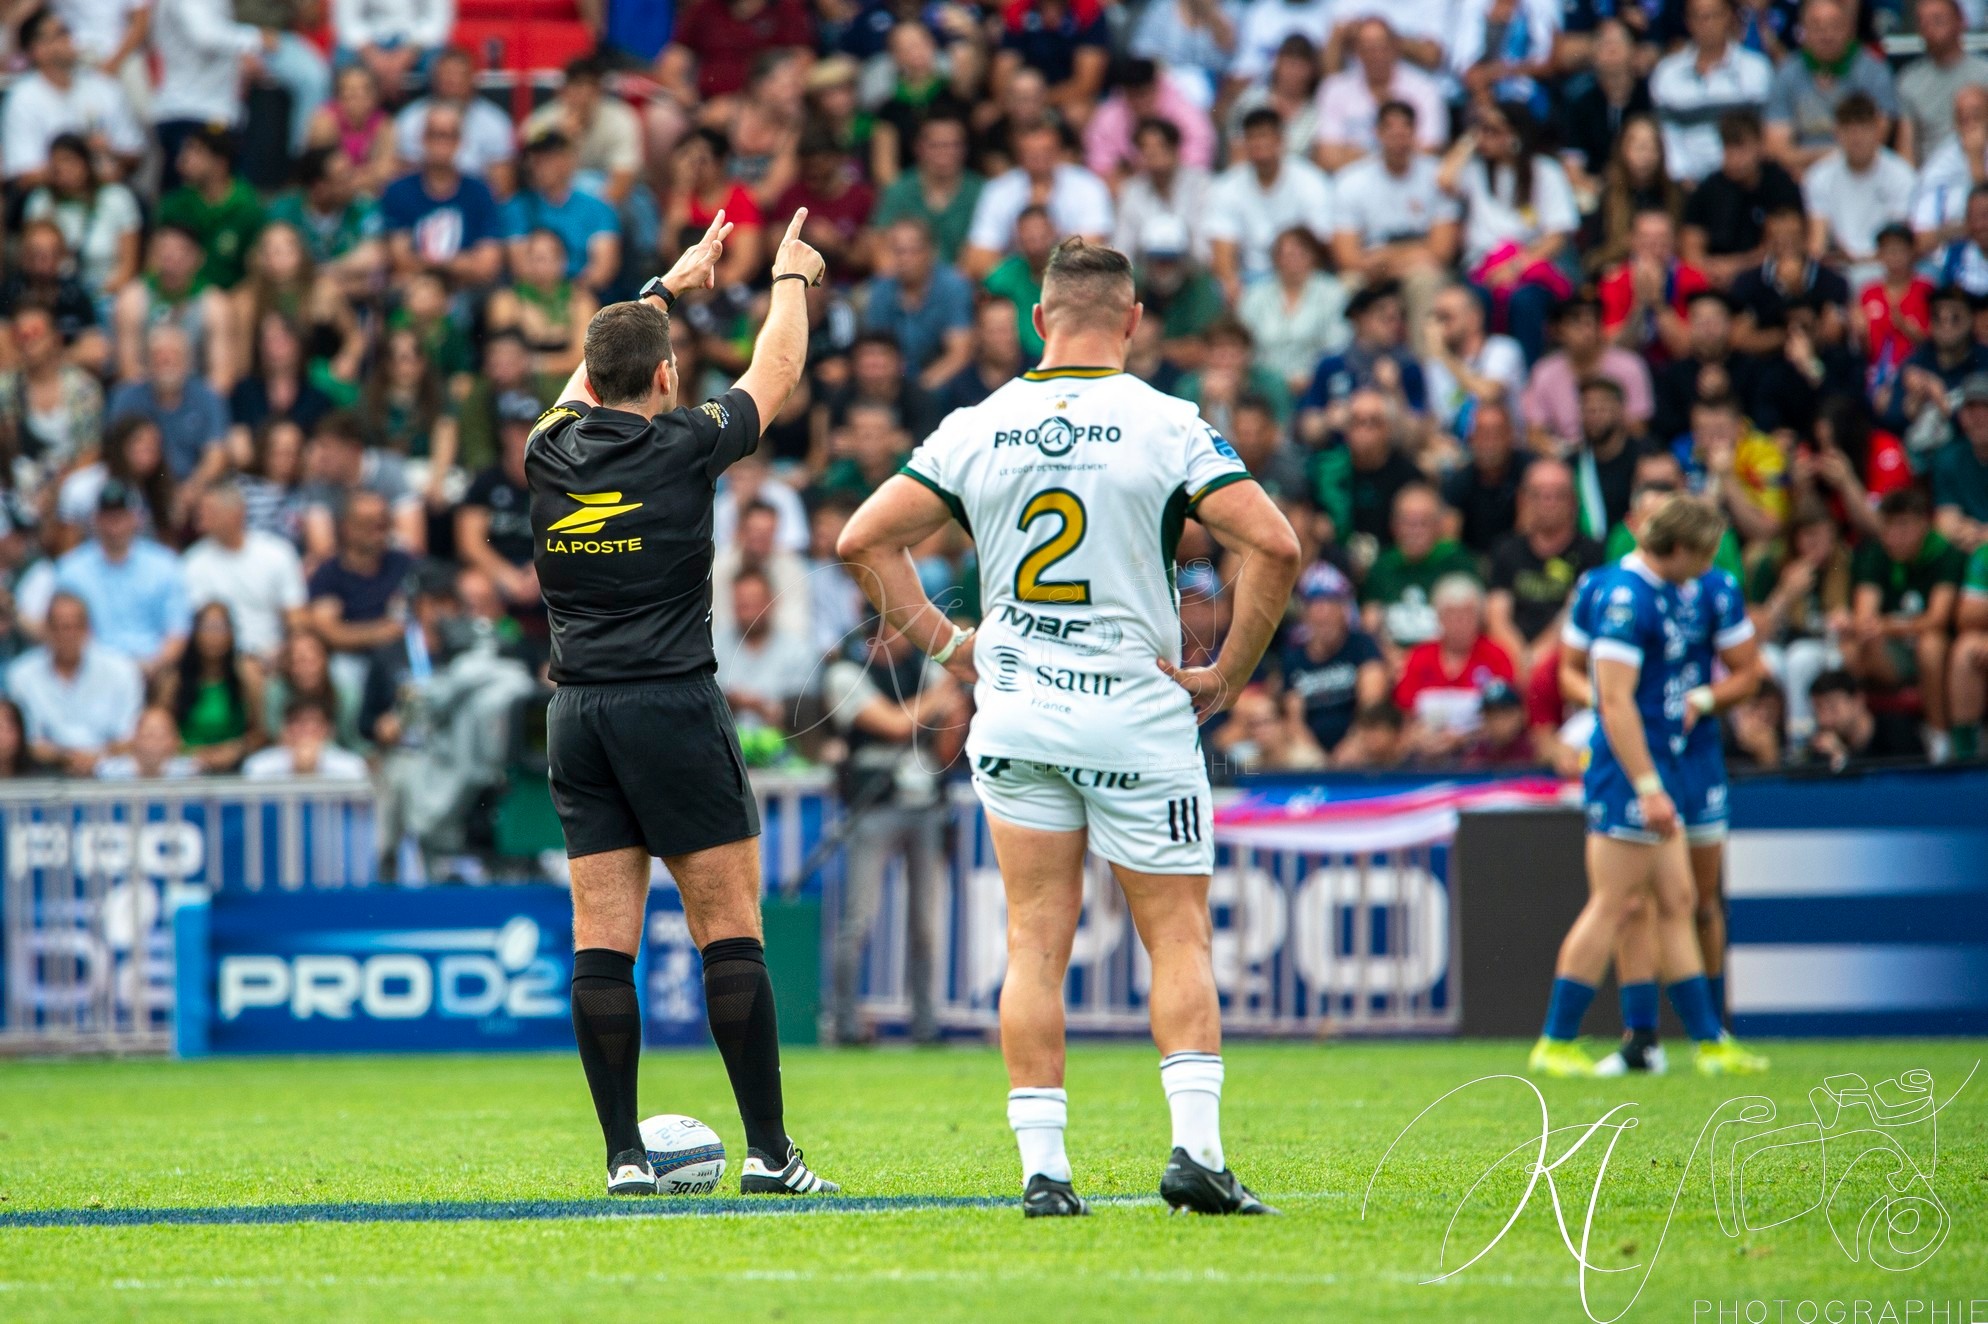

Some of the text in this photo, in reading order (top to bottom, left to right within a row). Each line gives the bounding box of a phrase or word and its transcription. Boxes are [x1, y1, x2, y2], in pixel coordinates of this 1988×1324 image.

[547, 537, 643, 554] LA POSTE
[1013, 487, 1092, 606] 2
[1036, 665, 1122, 696] saur
[1031, 698, 1072, 713] France
